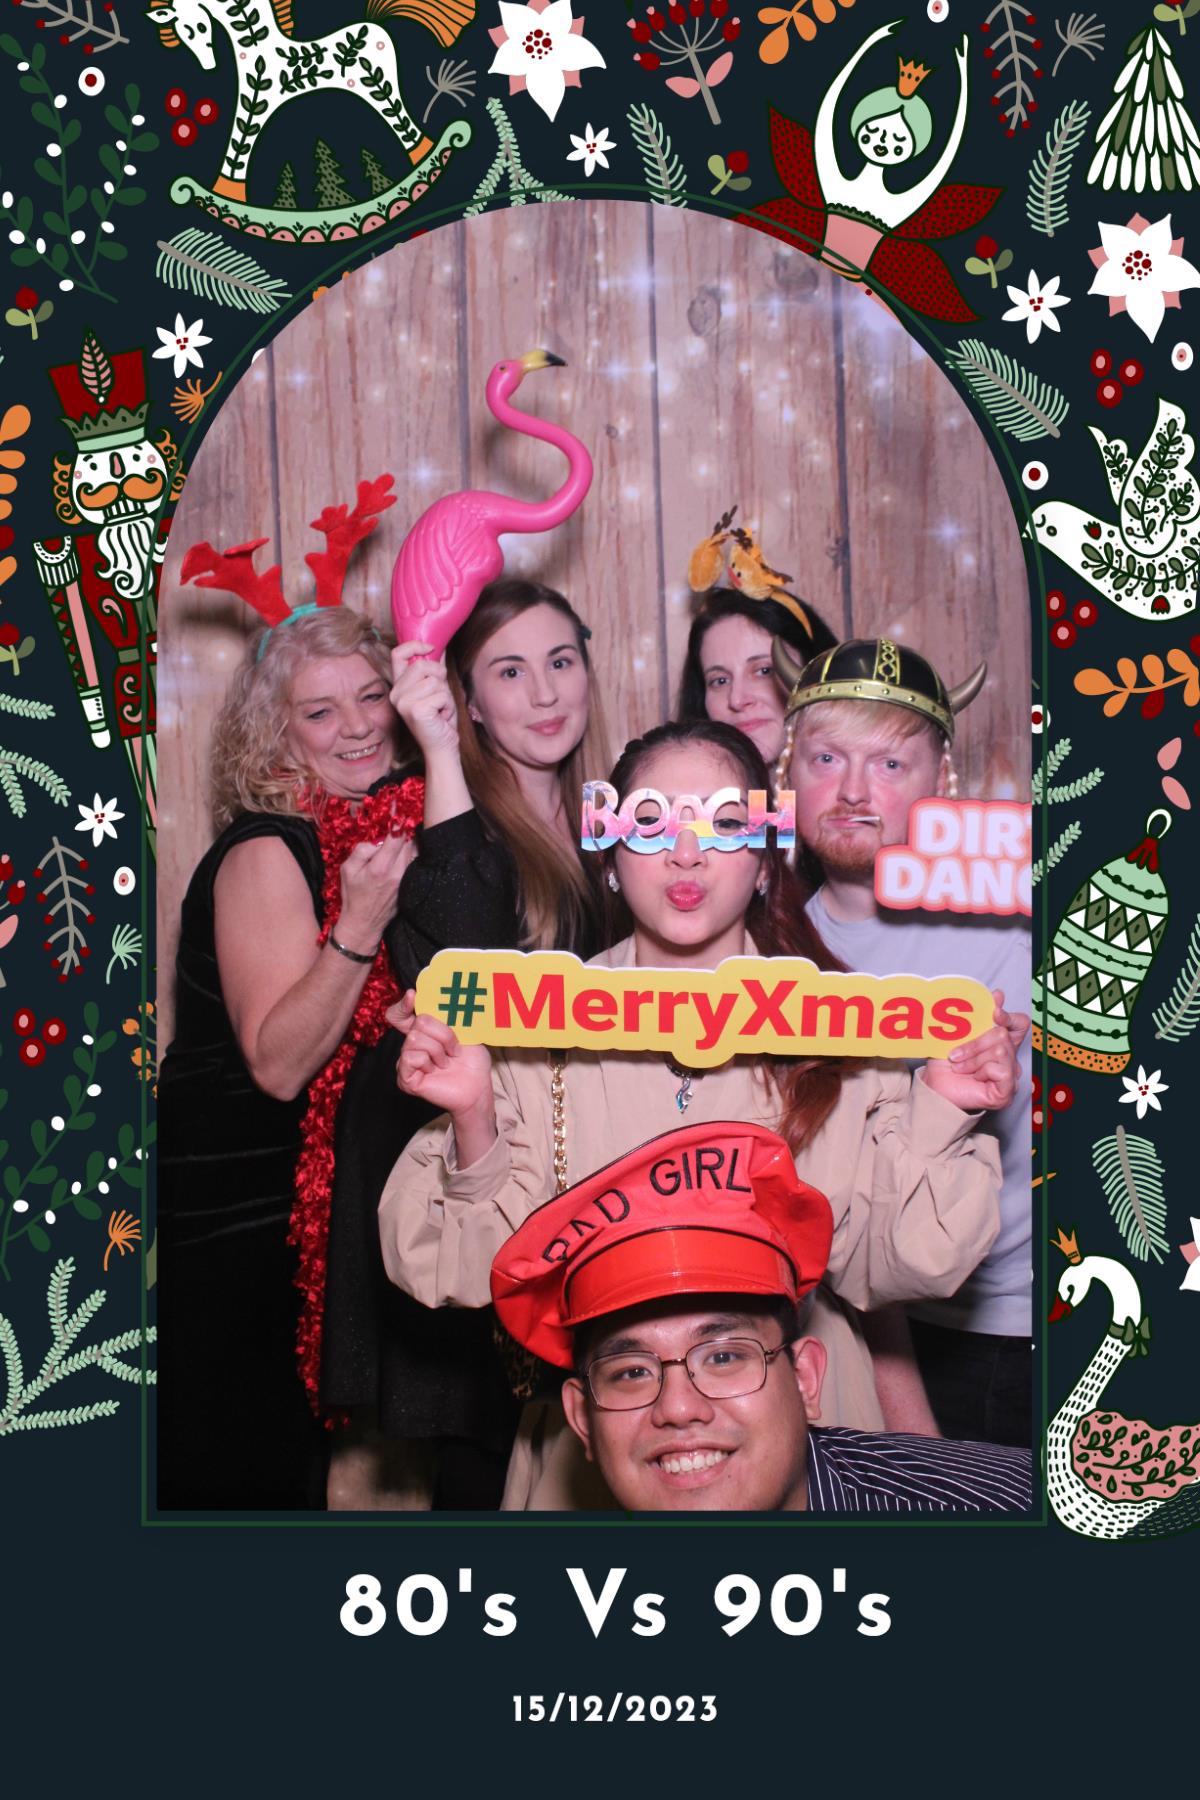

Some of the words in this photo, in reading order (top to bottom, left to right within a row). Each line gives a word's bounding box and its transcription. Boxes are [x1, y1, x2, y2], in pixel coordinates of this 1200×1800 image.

[917, 808, 1032, 856] DIR
[438, 971, 974, 1050] #MerryXmas
[650, 1148, 752, 1196] GIRL
